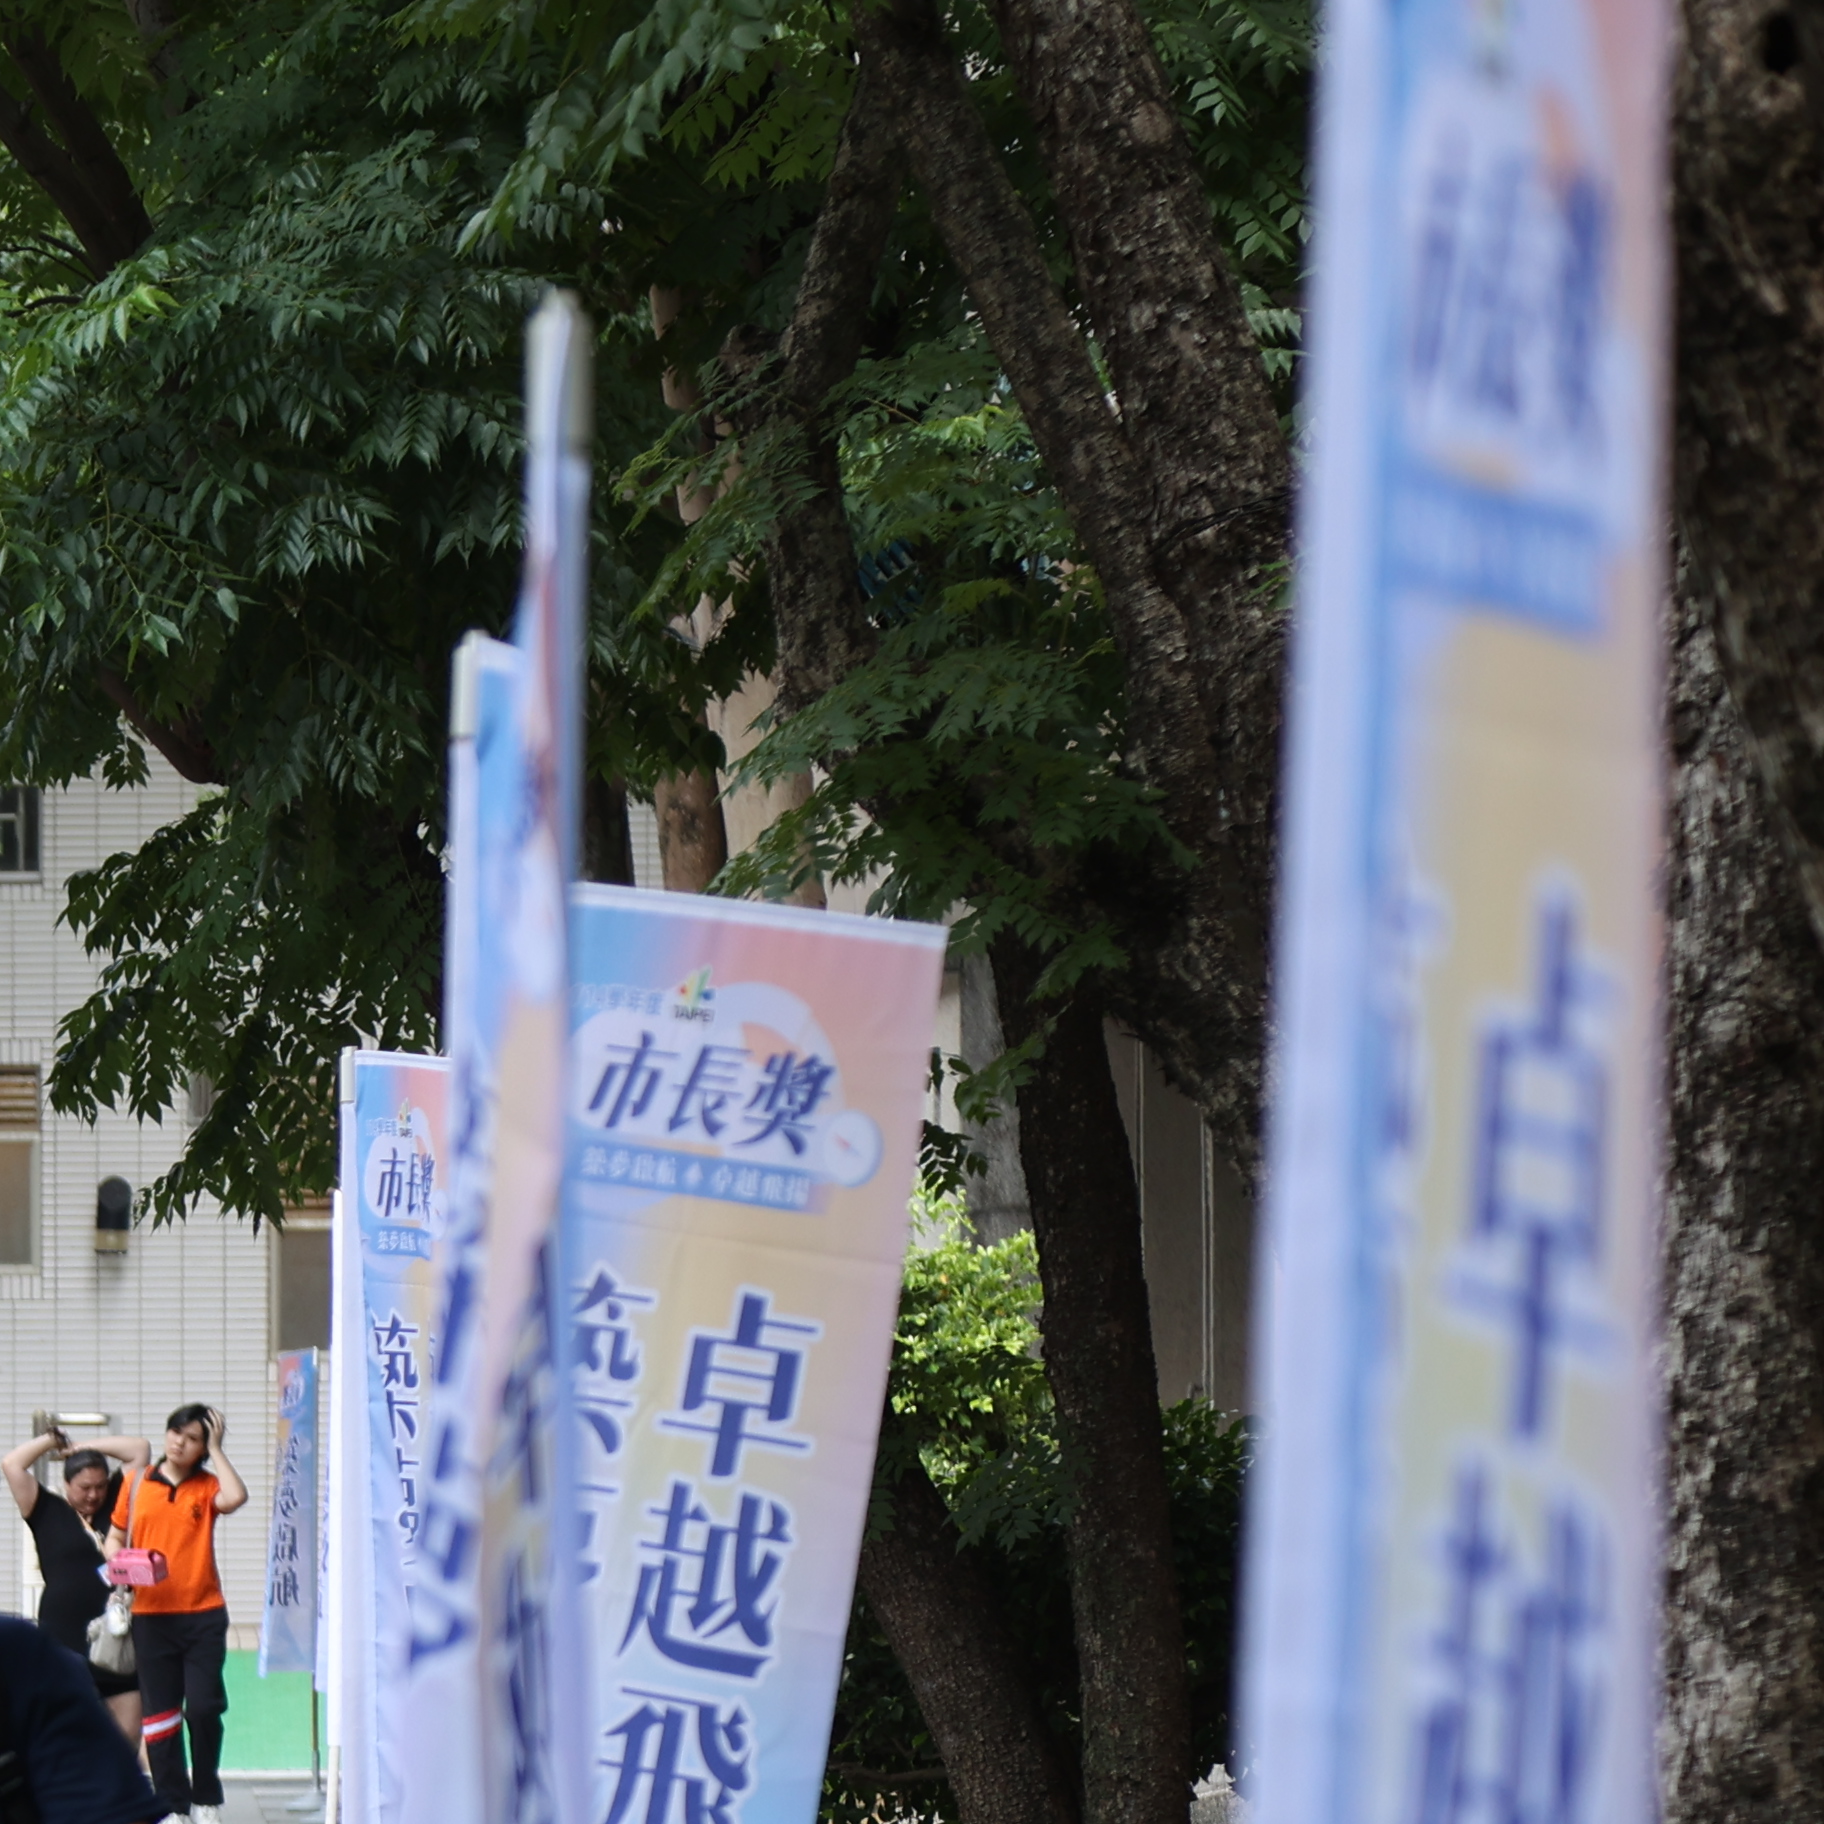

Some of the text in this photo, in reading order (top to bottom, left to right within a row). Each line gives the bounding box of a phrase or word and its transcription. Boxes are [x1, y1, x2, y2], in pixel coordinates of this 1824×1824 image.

[673, 1004, 715, 1022] TAIPEI
[588, 1030, 839, 1156] 市長獎
